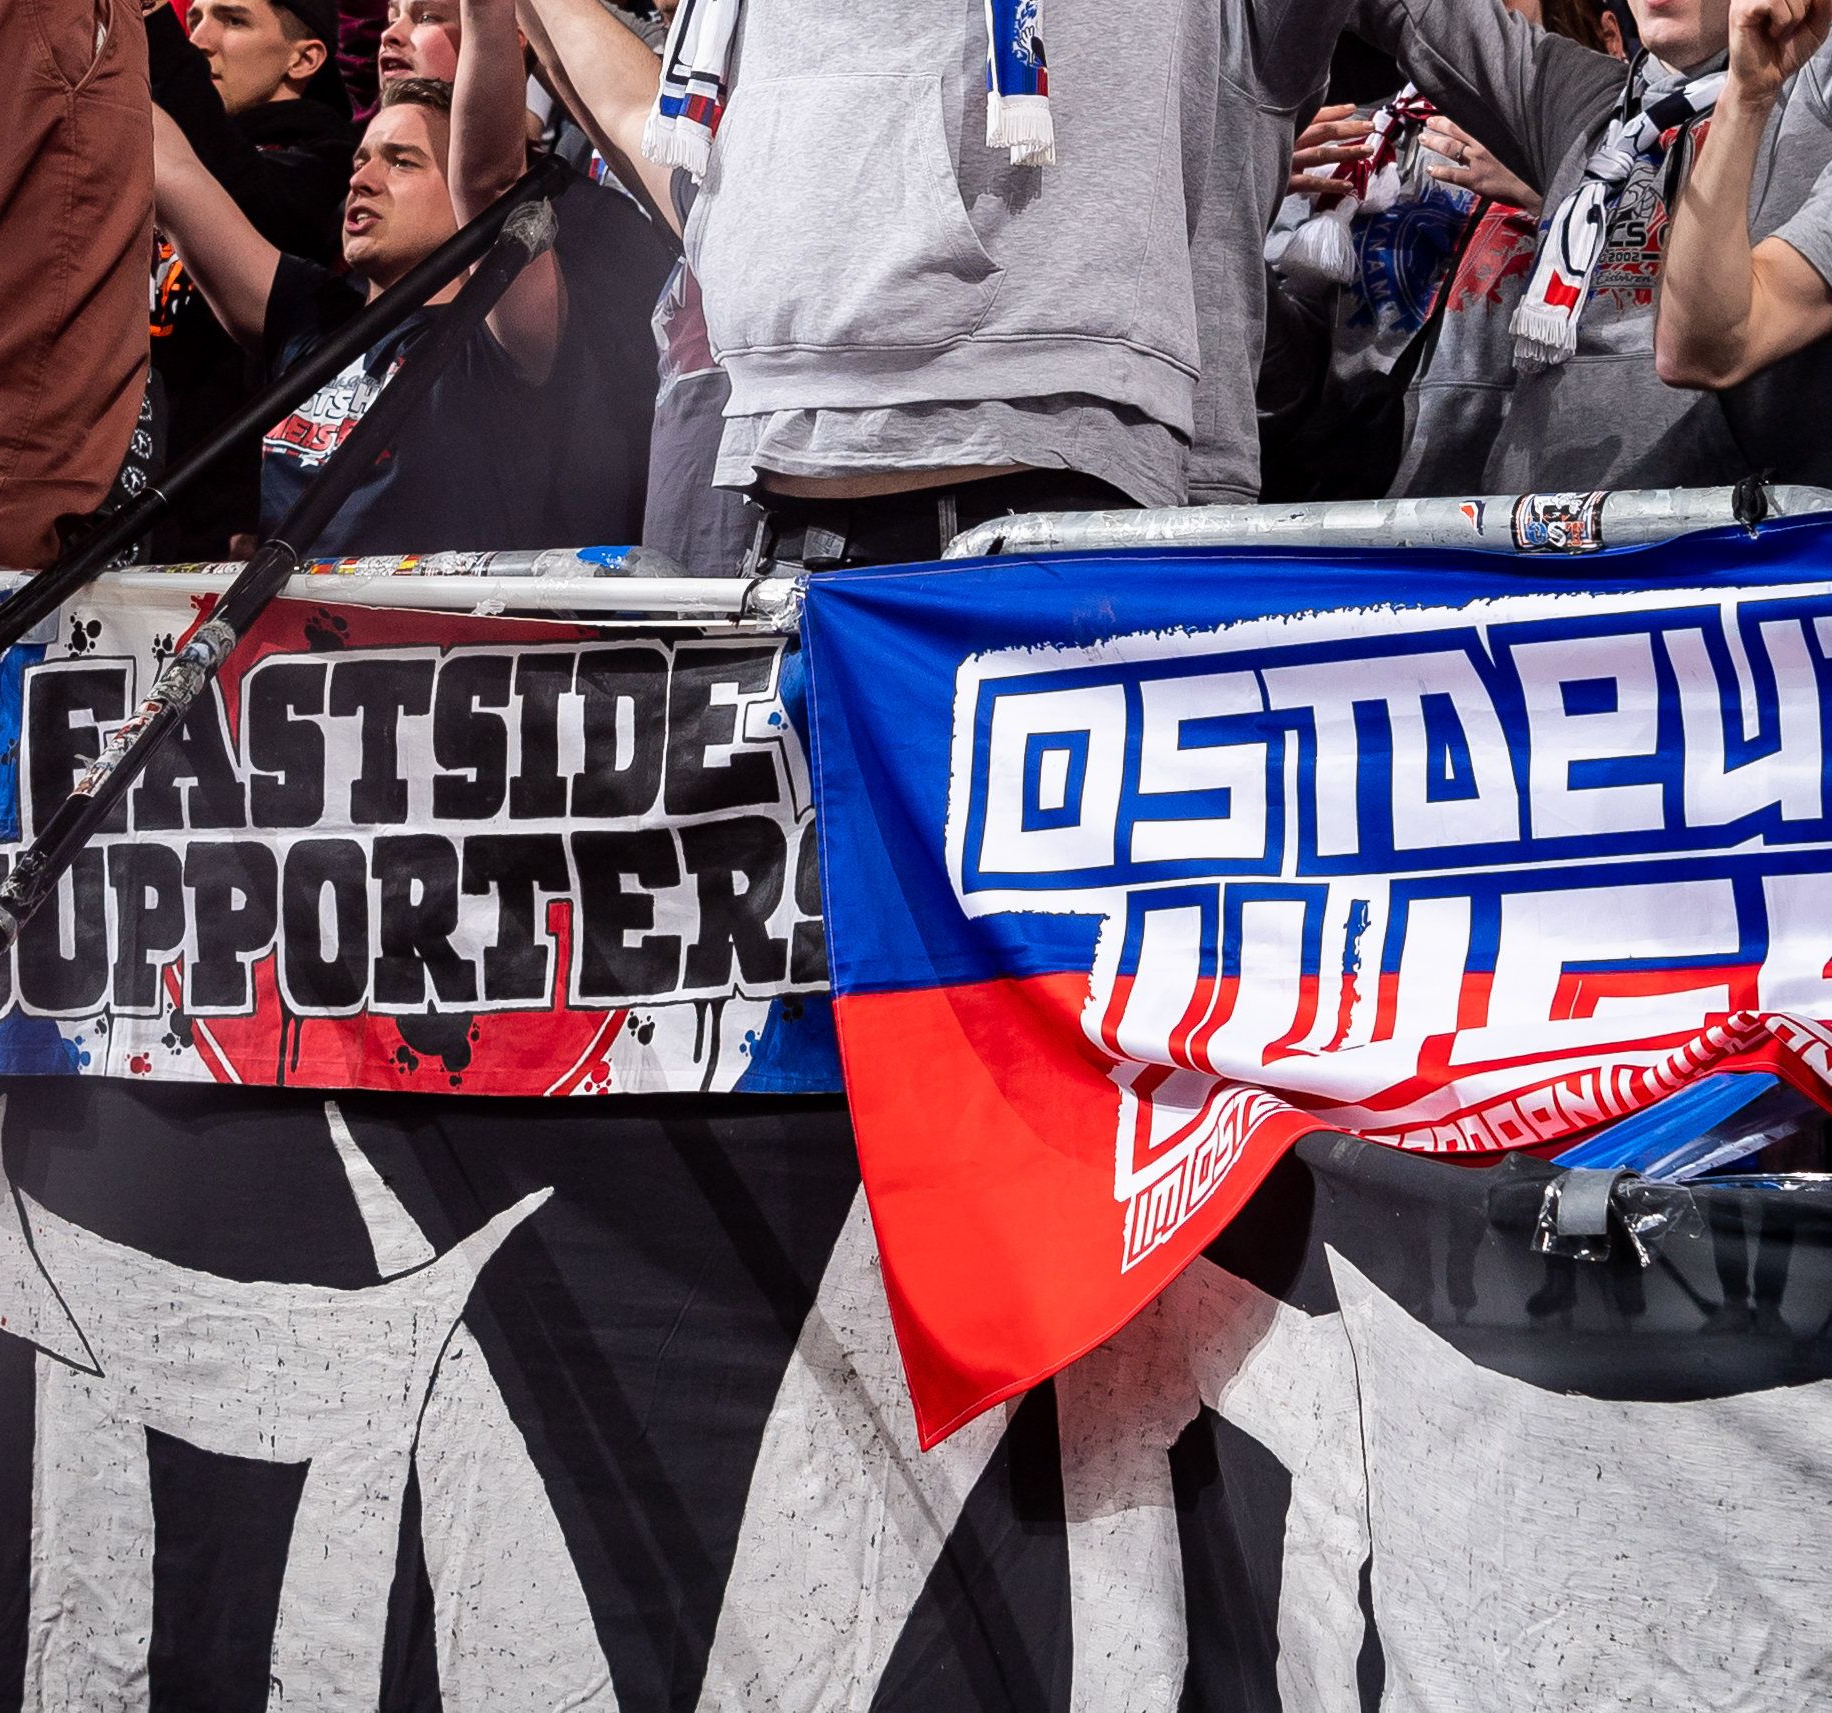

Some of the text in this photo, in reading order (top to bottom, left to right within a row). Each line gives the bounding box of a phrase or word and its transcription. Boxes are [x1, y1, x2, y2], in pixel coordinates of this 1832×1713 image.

[1609, 250, 1641, 264] 2002
[1528, 520, 1586, 547] OST
[22, 634, 789, 844] EASTSIDE
